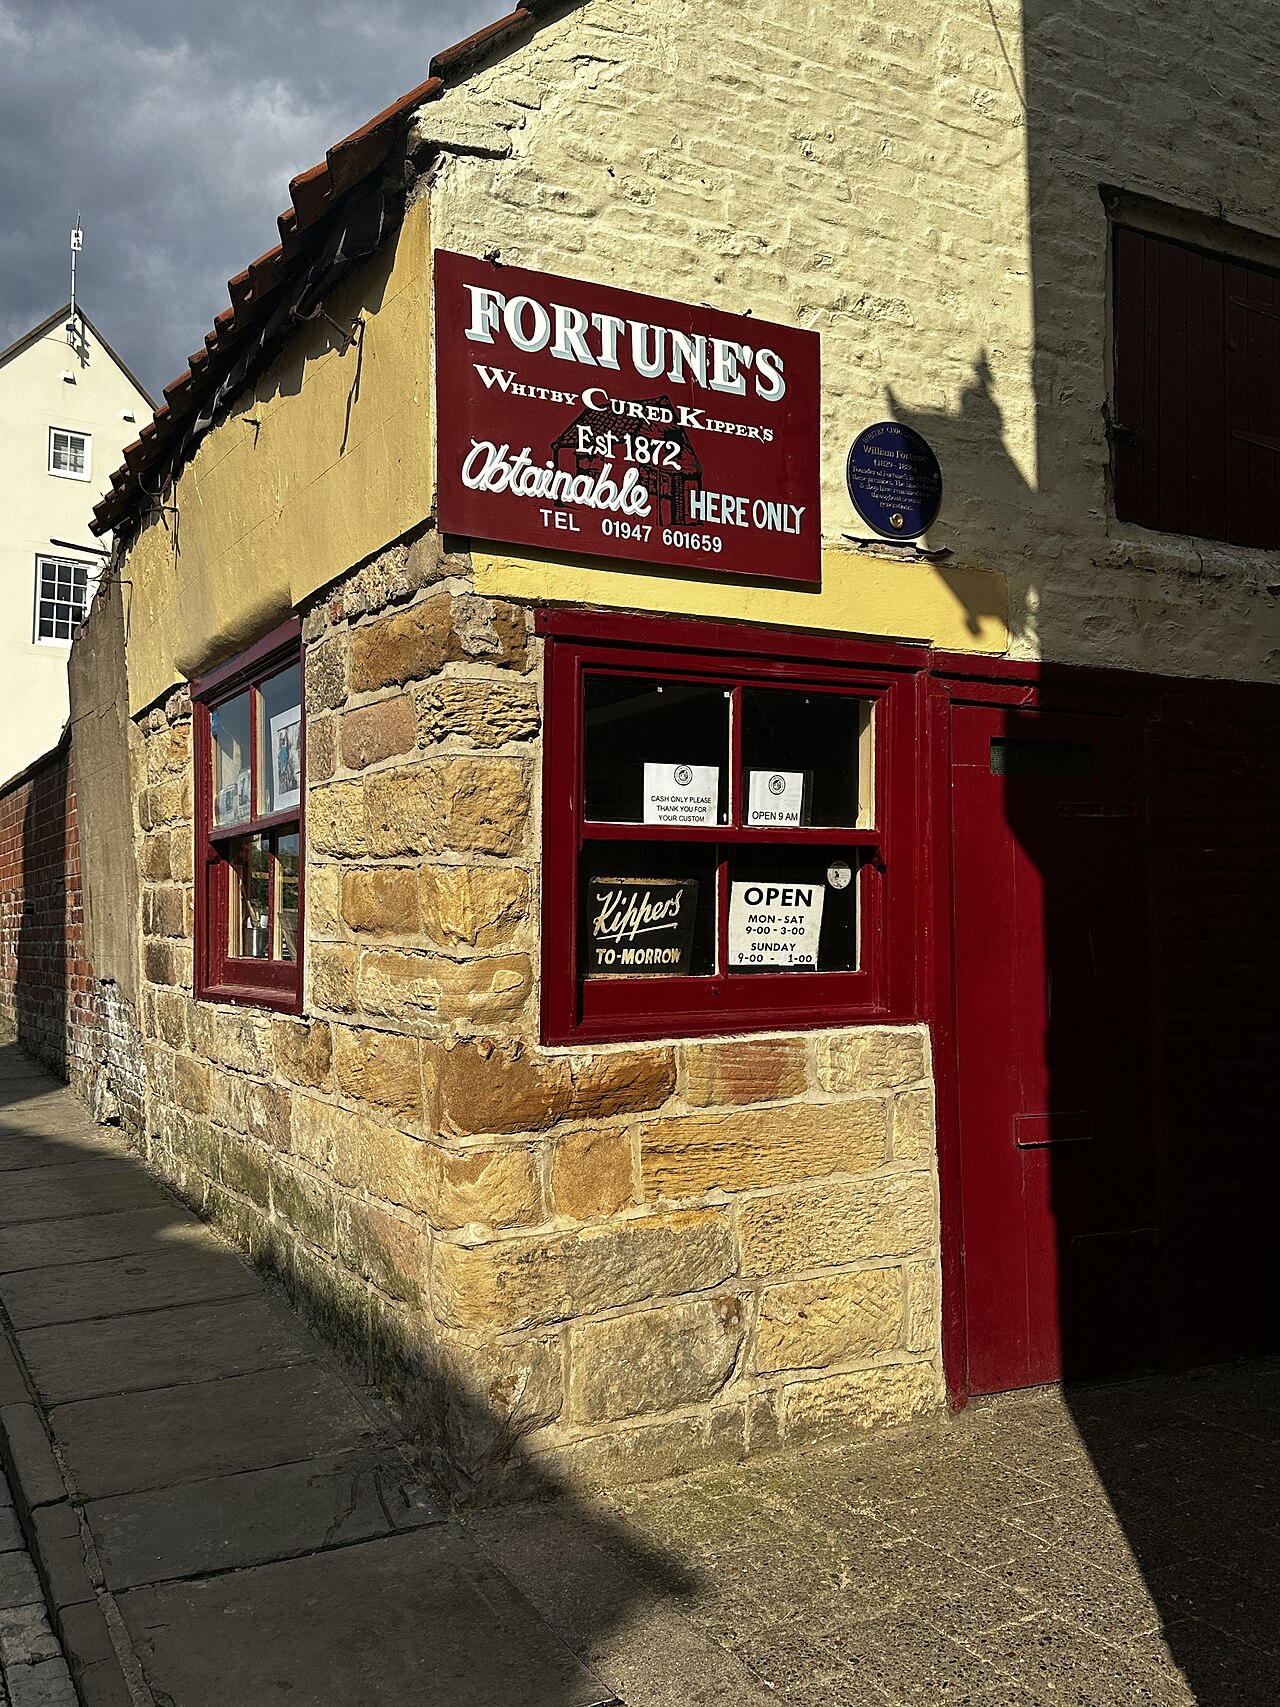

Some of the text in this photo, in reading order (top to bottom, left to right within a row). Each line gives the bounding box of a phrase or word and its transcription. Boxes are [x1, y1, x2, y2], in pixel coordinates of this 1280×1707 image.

[462, 283, 786, 402] FORTUNE'S
[473, 363, 774, 443] WHITBY CURED KIPPER'S
[576, 424, 682, 470] Est 1872
[862, 444, 929, 463] William Fortune
[461, 438, 652, 517] Obtainable
[689, 490, 805, 535] HERE ONLY
[540, 508, 722, 553] TEL 01947 601659
[650, 795, 712, 804] CASH ONLY PLEASE
[656, 805, 678, 813] THANK
[679, 805, 694, 813] YOU
[658, 814, 705, 823] YOUR CUSTOM
[751, 811, 798, 822] OPEN 9 AM
[744, 887, 813, 907] OPEN
[592, 889, 684, 944] Kippers
[745, 926, 771, 935] 9-00
[780, 926, 805, 936] 3-00
[595, 947, 682, 966] TO-MORROW
[751, 942, 796, 952] SUNDAY
[738, 952, 764, 963] 9-00
[787, 953, 812, 963] 1-00
